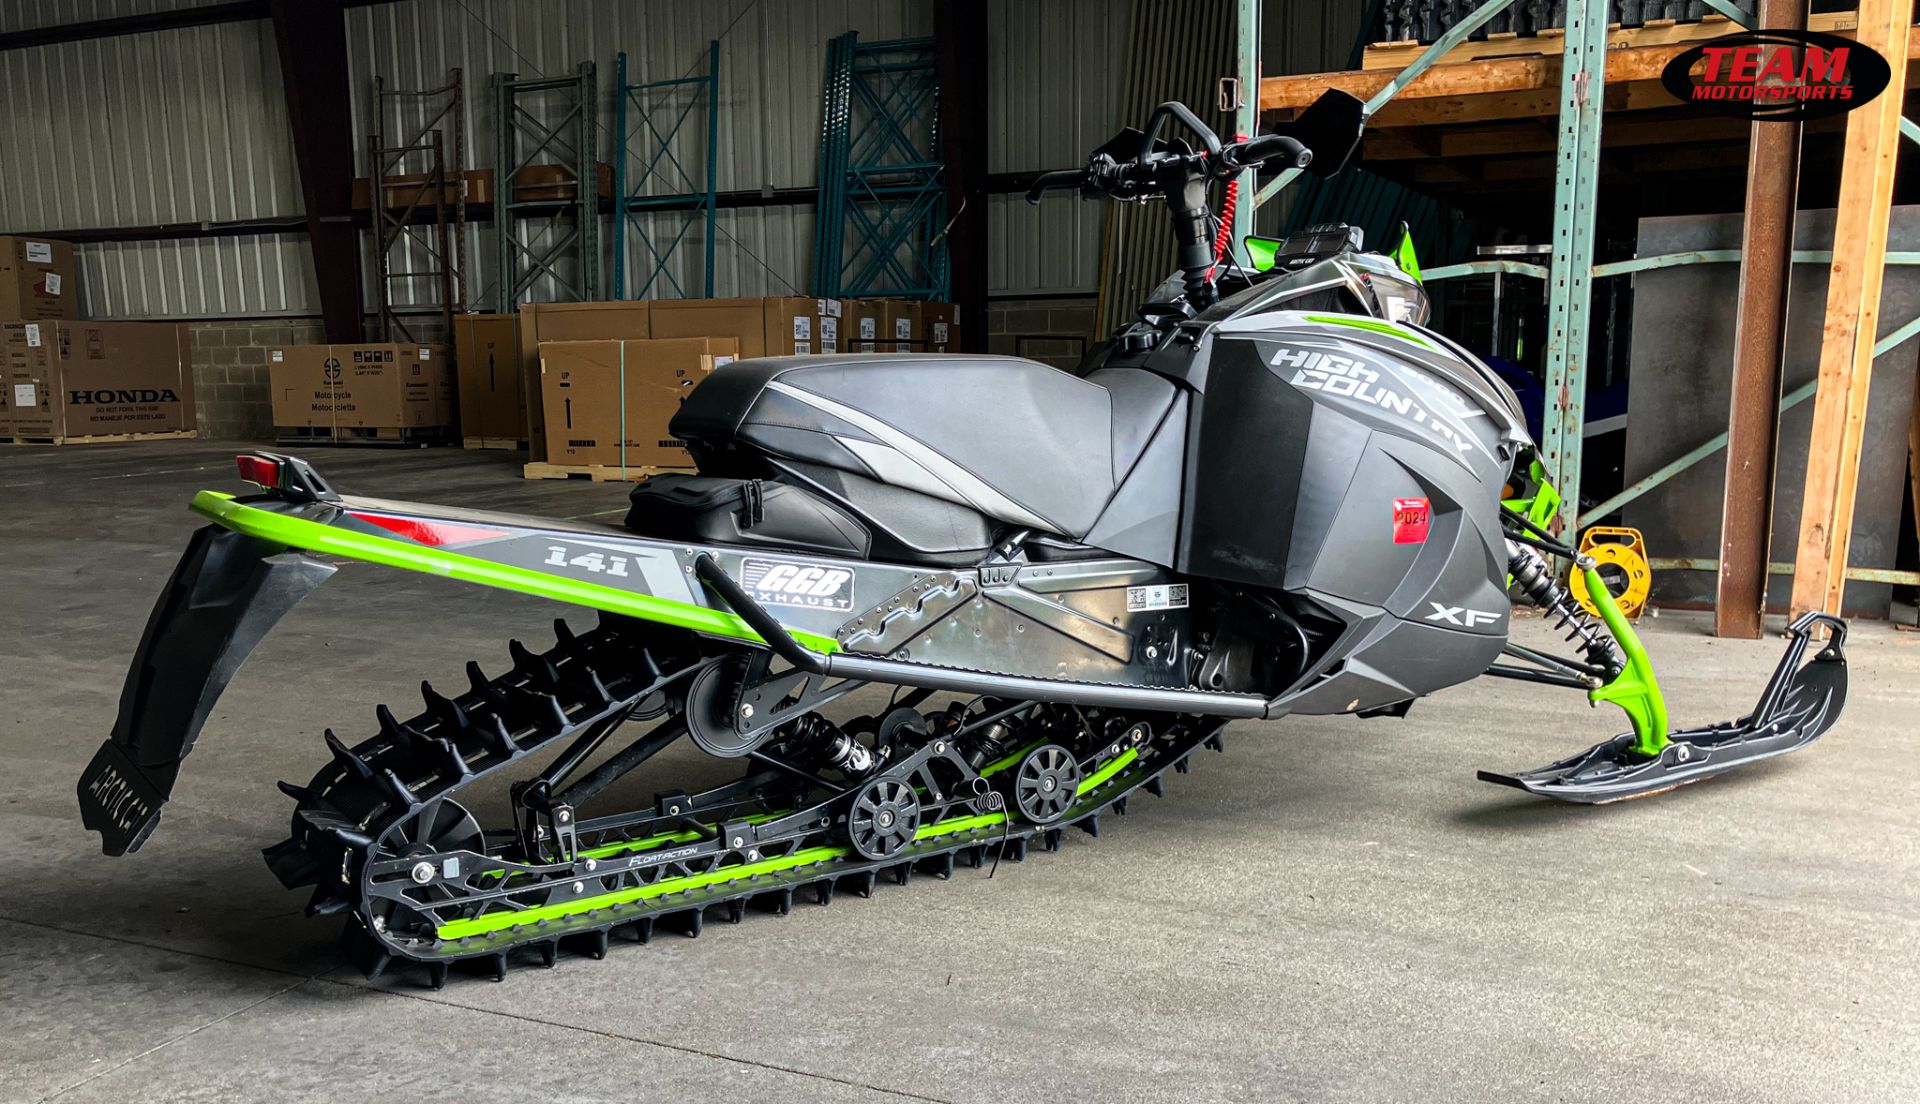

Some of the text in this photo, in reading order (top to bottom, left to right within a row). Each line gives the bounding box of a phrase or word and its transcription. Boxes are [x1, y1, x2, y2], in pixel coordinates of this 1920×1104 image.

[676, 369, 686, 378] UP
[1270, 348, 1380, 384] HIGH
[561, 372, 570, 380] UP
[69, 389, 180, 404] HONDA
[314, 391, 351, 400] Motorcycle
[1290, 368, 1473, 451] COUNTRY
[1397, 511, 1426, 525] 2024
[543, 546, 629, 577] 141
[1424, 601, 1502, 627] XF
